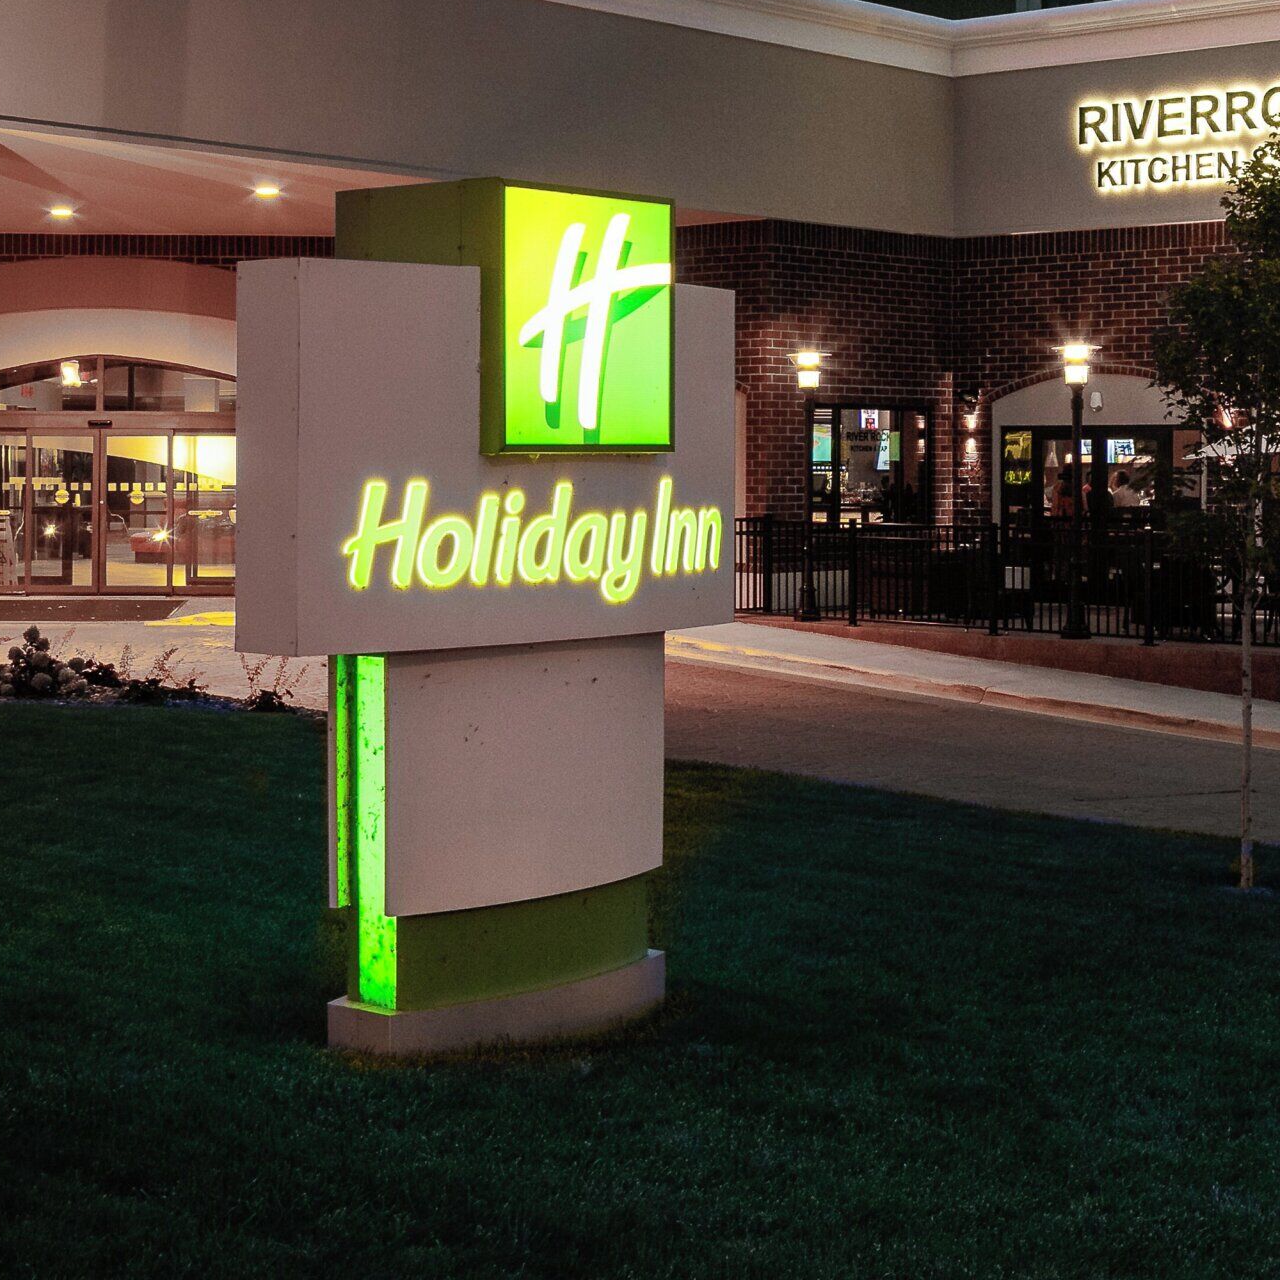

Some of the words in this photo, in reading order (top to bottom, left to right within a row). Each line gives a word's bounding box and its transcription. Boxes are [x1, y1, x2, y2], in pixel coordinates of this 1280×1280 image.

[1096, 149, 1240, 189] KITCHEN
[846, 431, 870, 442] RIVER
[342, 477, 648, 604] Holiday
[650, 475, 723, 576] Inn
